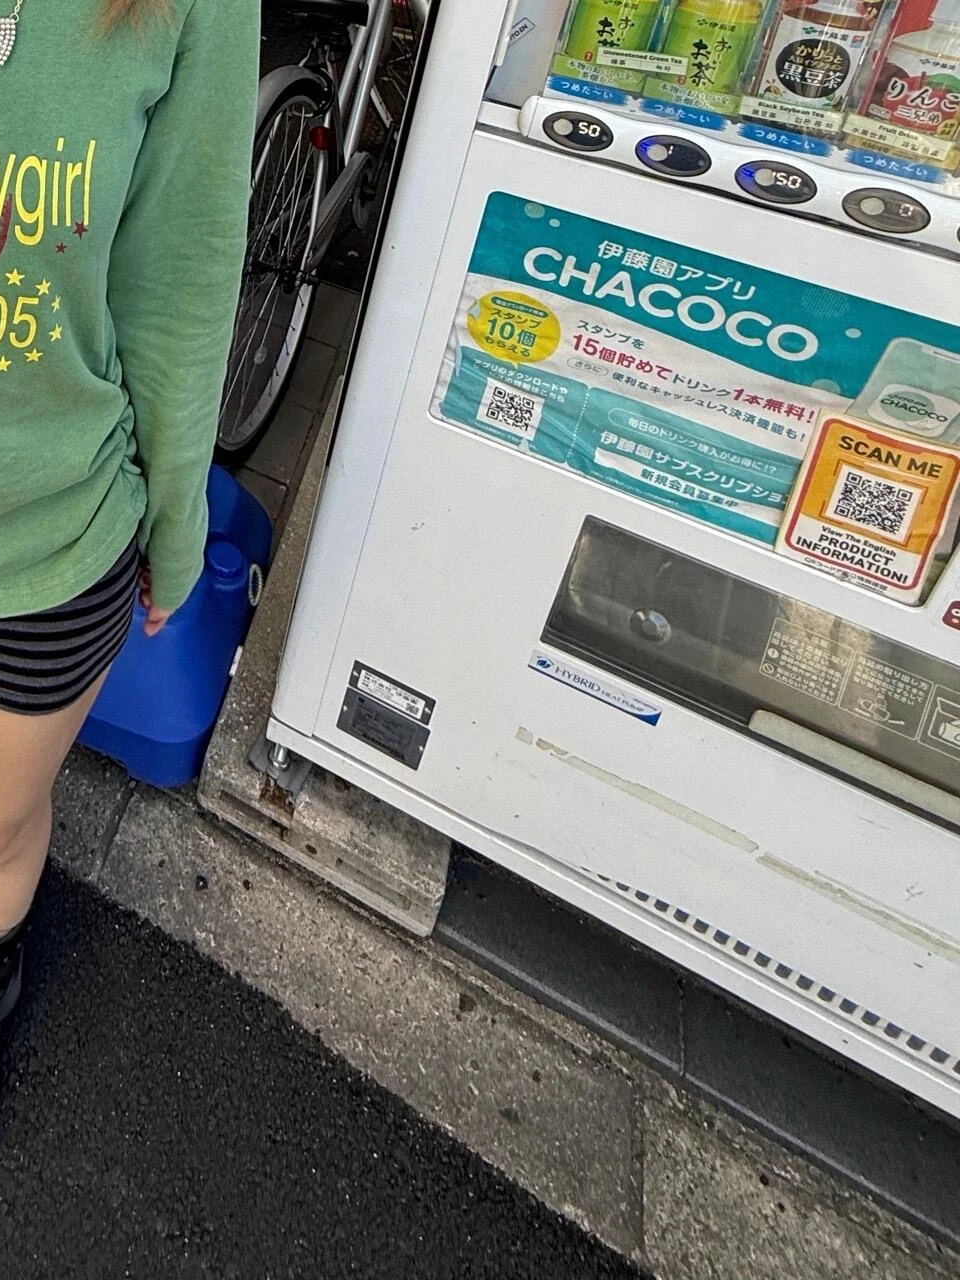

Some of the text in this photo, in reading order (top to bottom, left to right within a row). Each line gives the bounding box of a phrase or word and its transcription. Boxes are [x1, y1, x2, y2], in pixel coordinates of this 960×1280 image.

[603, 49, 648, 60] Unsweetened
[649, 54, 669, 63] Green
[779, 61, 844, 89] 黒豆茶
[757, 101, 778, 110] Black
[779, 105, 810, 115] Soybean
[893, 105, 942, 125] 三兄弟
[577, 121, 601, 137] 50
[878, 124, 897, 136] Fruit
[597, 239, 756, 302] 伊藤園アプリ
[490, 308, 543, 329] スタンプ
[522, 246, 820, 363] CHACOCO
[484, 335, 531, 358] もらえる
[487, 317, 537, 348] 10個
[577, 319, 647, 351] スタンプを
[574, 360, 603, 374] さらに
[880, 398, 948, 423] CHACOCO
[600, 430, 788, 505] 伊藤園サブスクリプショ
[838, 434, 943, 479] SCAN ME
[818, 533, 895, 566] PRODUCT
[821, 525, 897, 558] View The English
[796, 535, 909, 585] INFORMATION!
[554, 664, 601, 693] HYBRID
